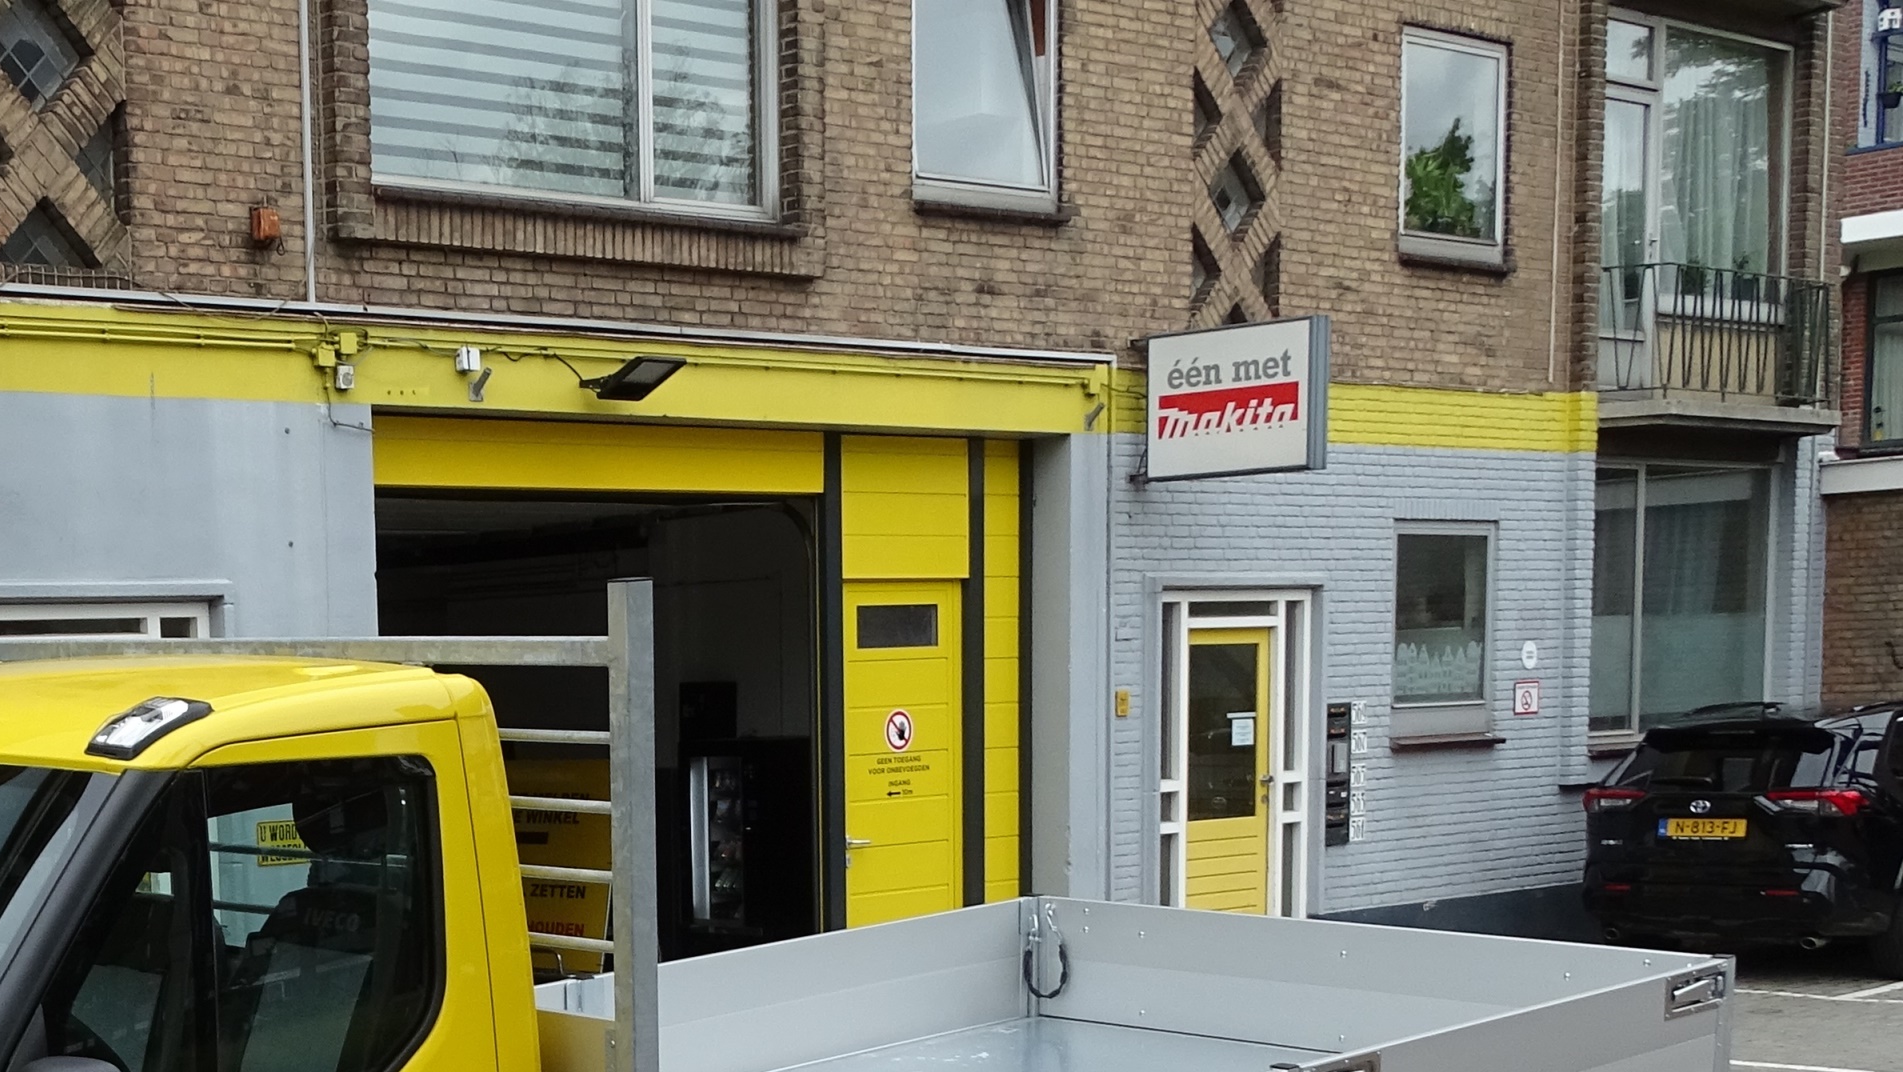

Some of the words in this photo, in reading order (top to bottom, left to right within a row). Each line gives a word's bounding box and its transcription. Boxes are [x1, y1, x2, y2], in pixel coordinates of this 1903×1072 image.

[1167, 357, 1222, 389] één
[1231, 349, 1292, 383] met
[868, 767, 885, 775] VOOR
[269, 823, 298, 842] WORD
[1675, 820, 1738, 834] N-813-FJ
[530, 884, 586, 899] ZETTEN
